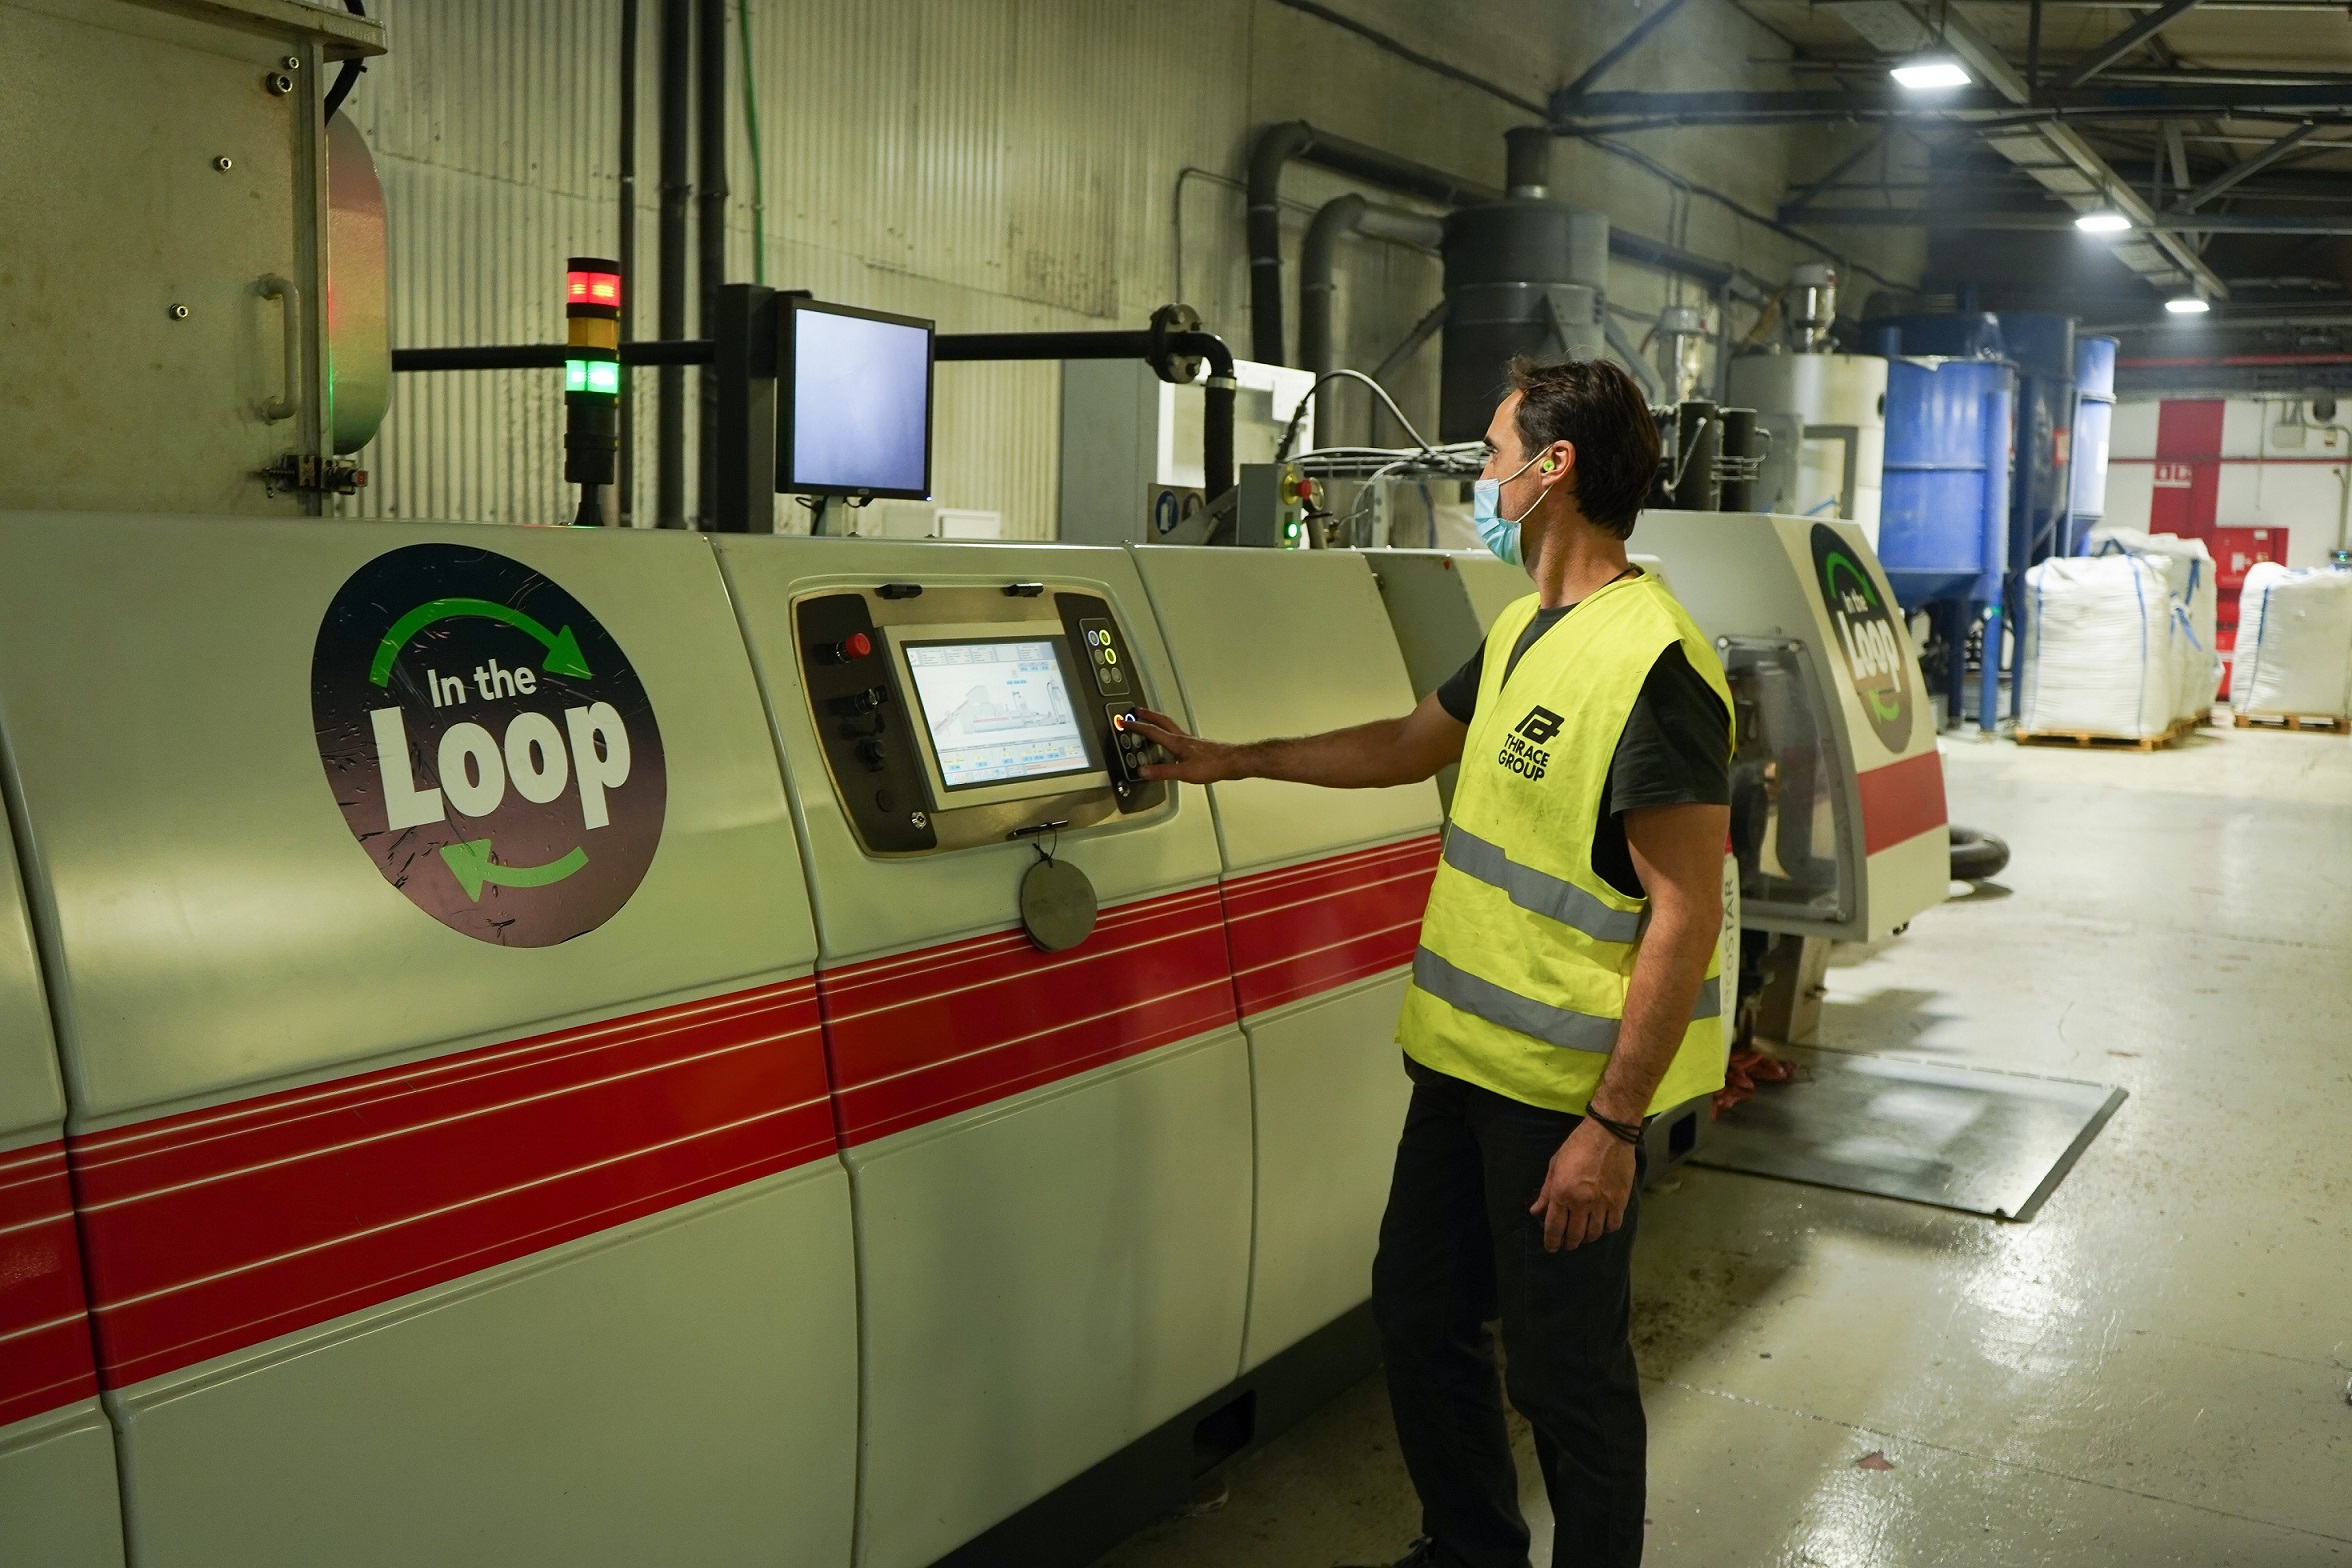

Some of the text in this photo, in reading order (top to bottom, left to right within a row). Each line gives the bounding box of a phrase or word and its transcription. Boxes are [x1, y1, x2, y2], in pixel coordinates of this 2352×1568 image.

[1837, 610, 1901, 693] Loop
[428, 658, 536, 707] In the
[369, 701, 630, 830] Loop
[1498, 749, 1545, 782] GROUP
[1504, 733, 1550, 767] THRACE
